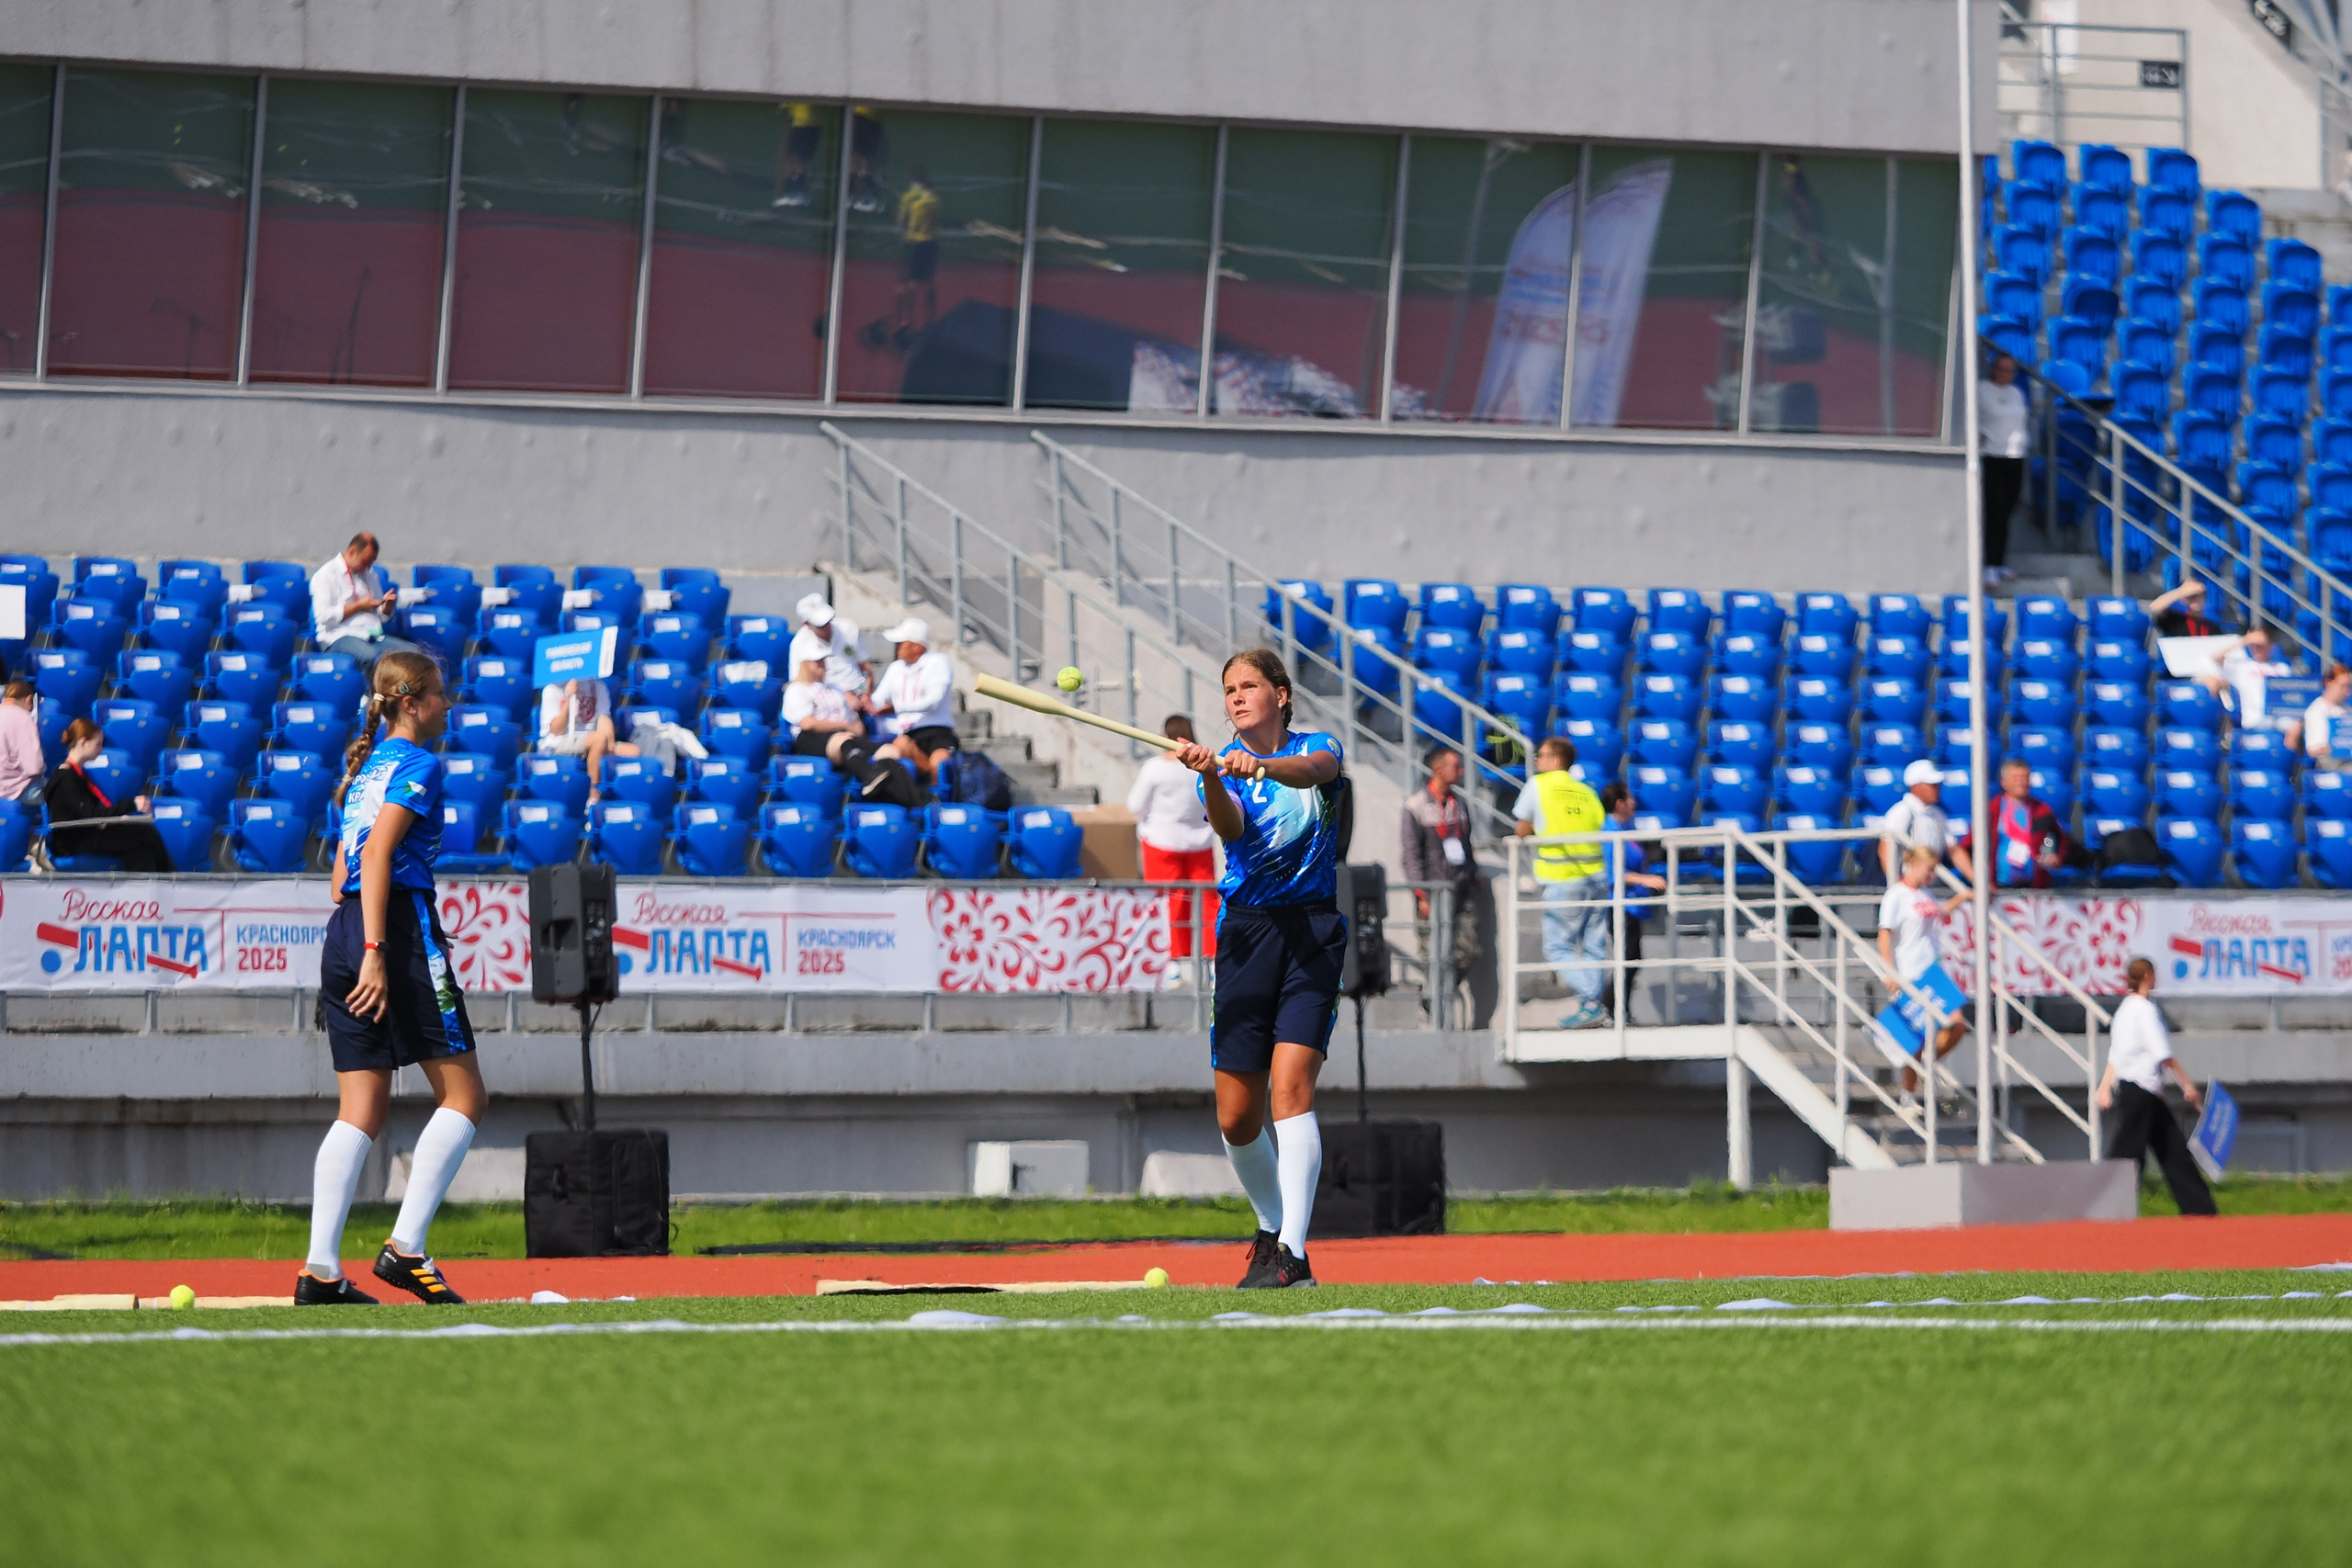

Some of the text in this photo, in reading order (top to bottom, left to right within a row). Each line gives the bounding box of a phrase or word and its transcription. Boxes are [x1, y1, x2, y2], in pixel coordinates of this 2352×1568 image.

[236, 924, 328, 944] КРАСНОЯРС
[797, 929, 897, 949] КРАСНОЯРСК
[74, 925, 209, 973] ЛАПТА
[238, 947, 288, 971] 2025
[646, 930, 771, 974] ЛАПТА
[2199, 938, 2311, 978] ЛАПТА
[798, 950, 845, 974] 2025
